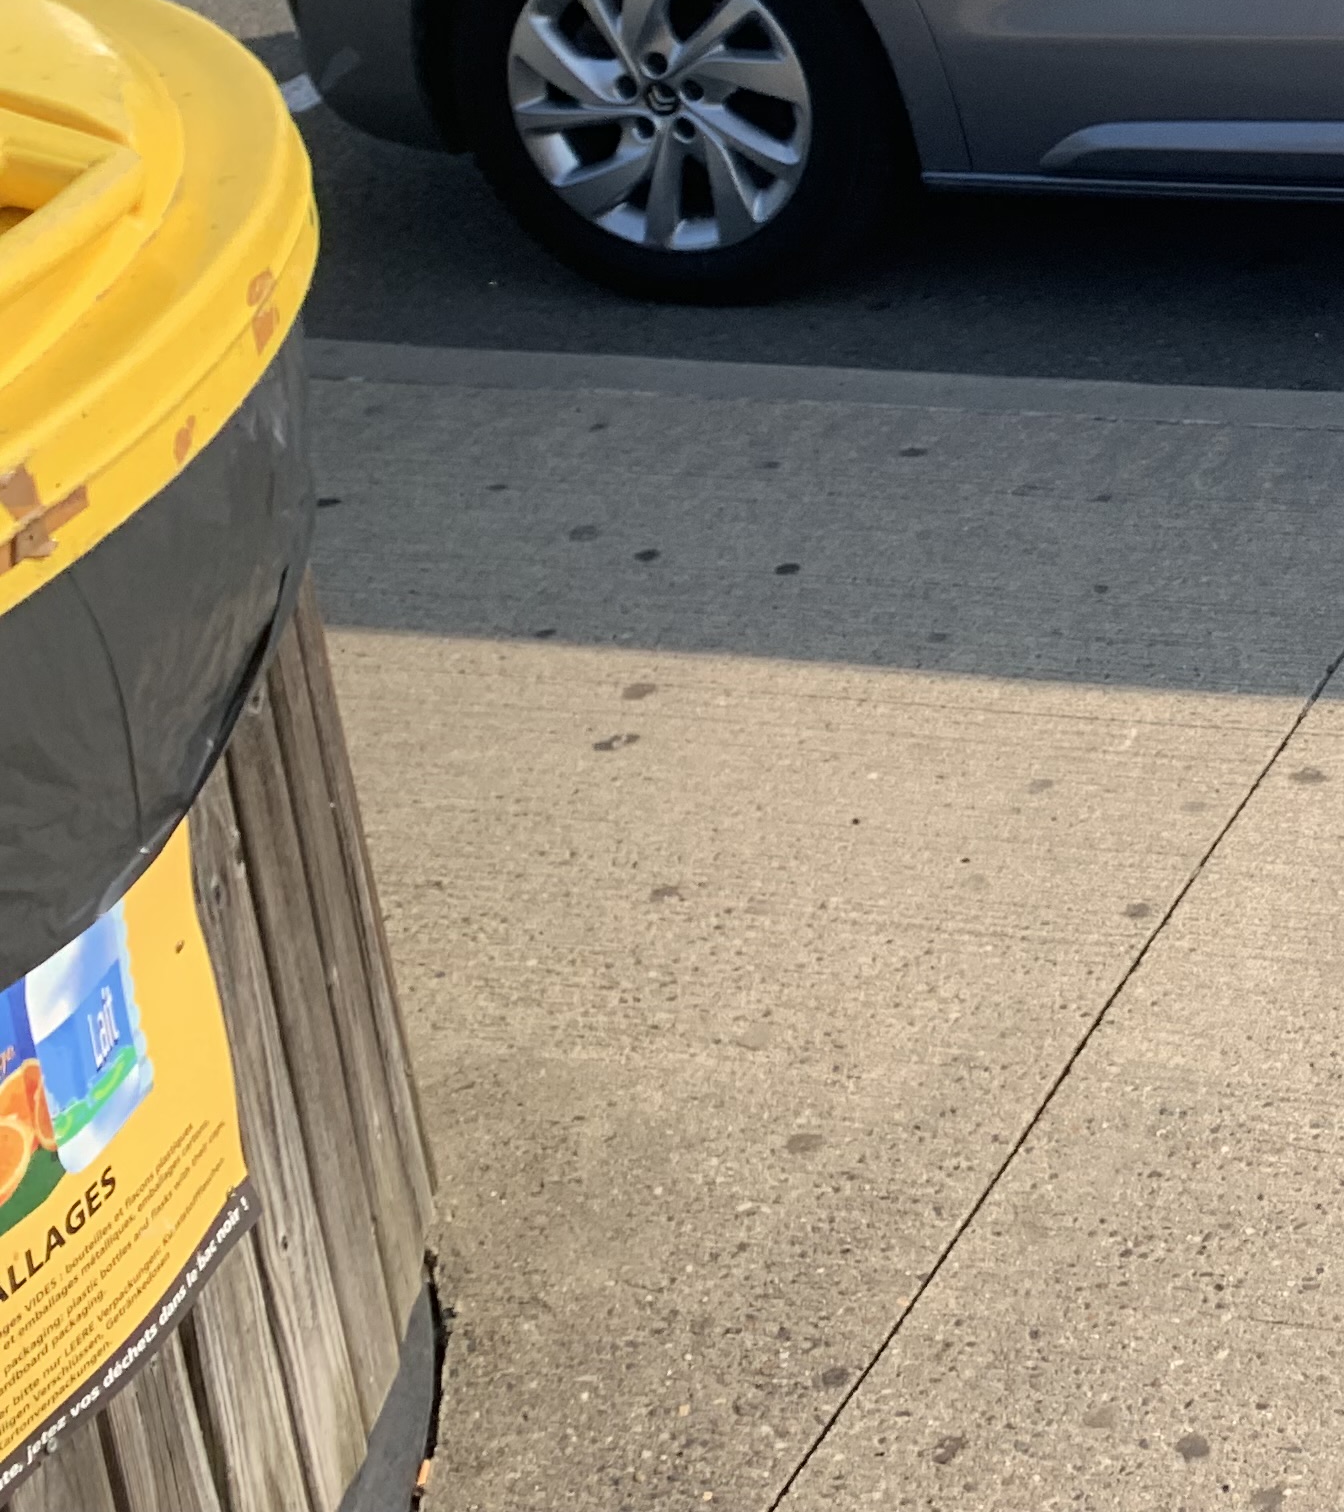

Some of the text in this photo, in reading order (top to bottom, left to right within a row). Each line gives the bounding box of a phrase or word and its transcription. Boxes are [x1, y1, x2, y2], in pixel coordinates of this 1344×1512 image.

[87, 985, 120, 1069] Lait
[0, 1312, 22, 1339] ges
[24, 1277, 57, 1312] VIDES
[65, 1222, 112, 1274] bouteilles
[114, 1207, 124, 1222] et
[3, 1335, 15, 1350] et
[18, 1274, 79, 1337] emballages
[67, 1278, 98, 1318] plastic
[100, 1241, 132, 1280] bottles
[13, 1378, 40, 1406] bitte
[43, 1356, 61, 1379] nur
[64, 1321, 95, 1357] LEERE
[26, 1415, 67, 1466] jetez
[69, 1385, 100, 1418] vos
[102, 1322, 159, 1388] déchets
[158, 1284, 188, 1326] dans
[186, 1268, 198, 1288] le
[197, 1249, 218, 1273] bac
[216, 1207, 240, 1244] noir
